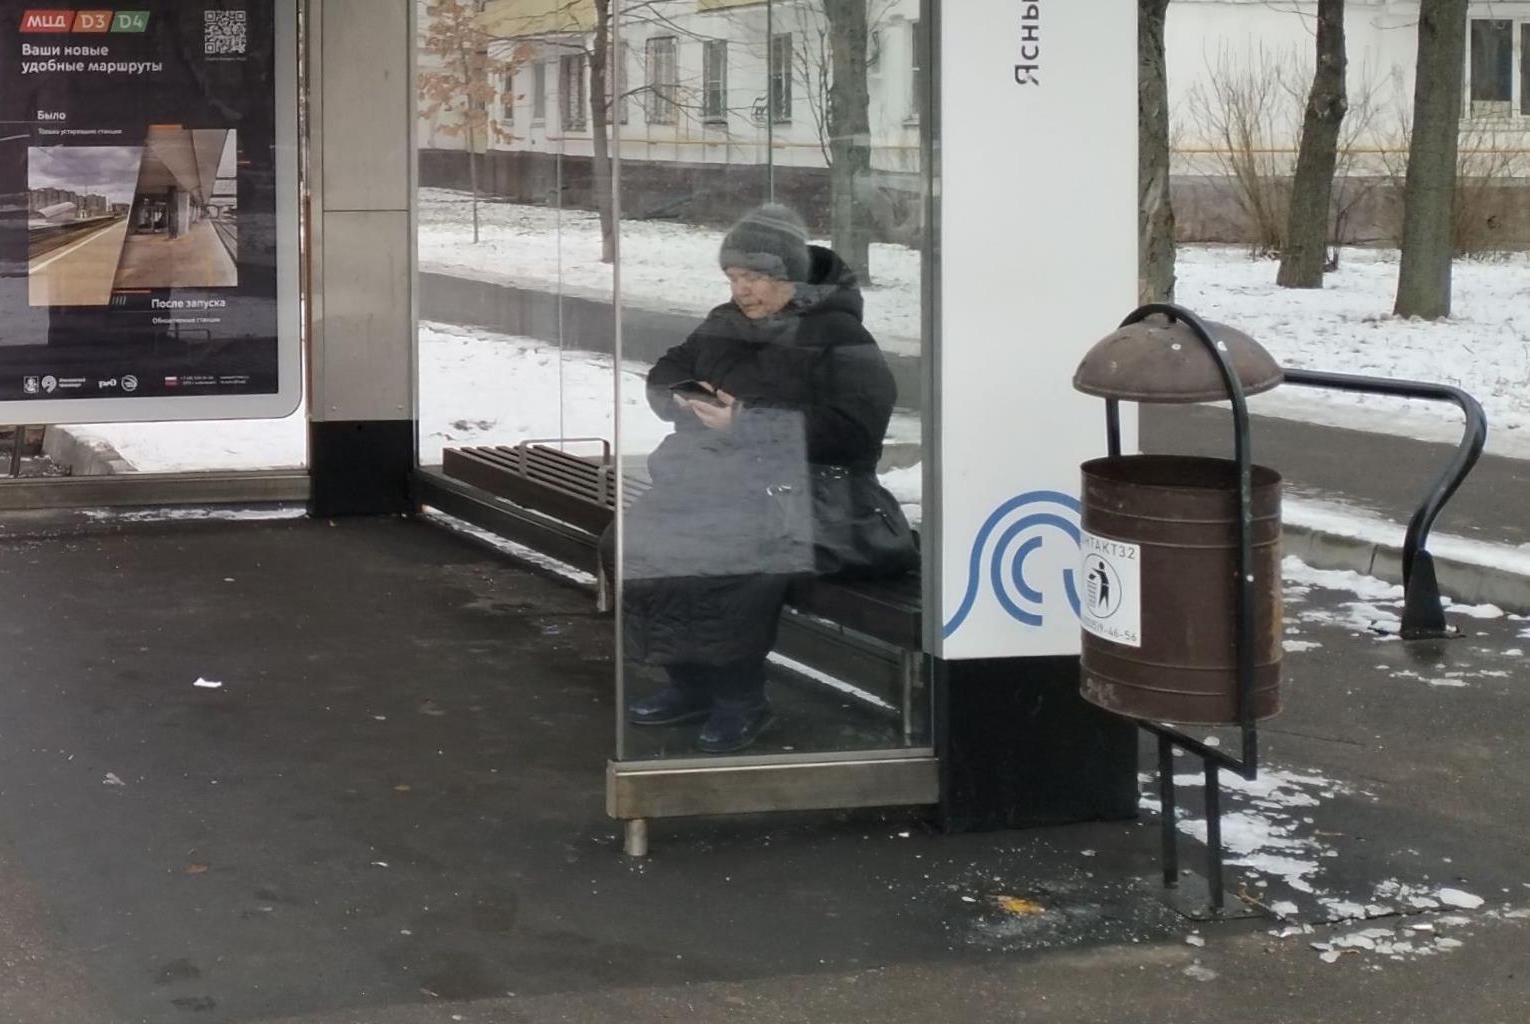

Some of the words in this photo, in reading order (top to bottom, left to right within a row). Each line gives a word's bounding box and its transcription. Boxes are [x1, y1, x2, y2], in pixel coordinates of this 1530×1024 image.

[26, 15, 66, 28] МЦД
[80, 14, 105, 29] D3
[118, 14, 144, 29] D4
[21, 44, 60, 56] Ваши
[64, 45, 109, 56] новые
[21, 59, 84, 74] удобные
[88, 61, 163, 74] маршруты
[37, 110, 67, 120] Было
[151, 298, 184, 309] После
[185, 299, 226, 309] запуска
